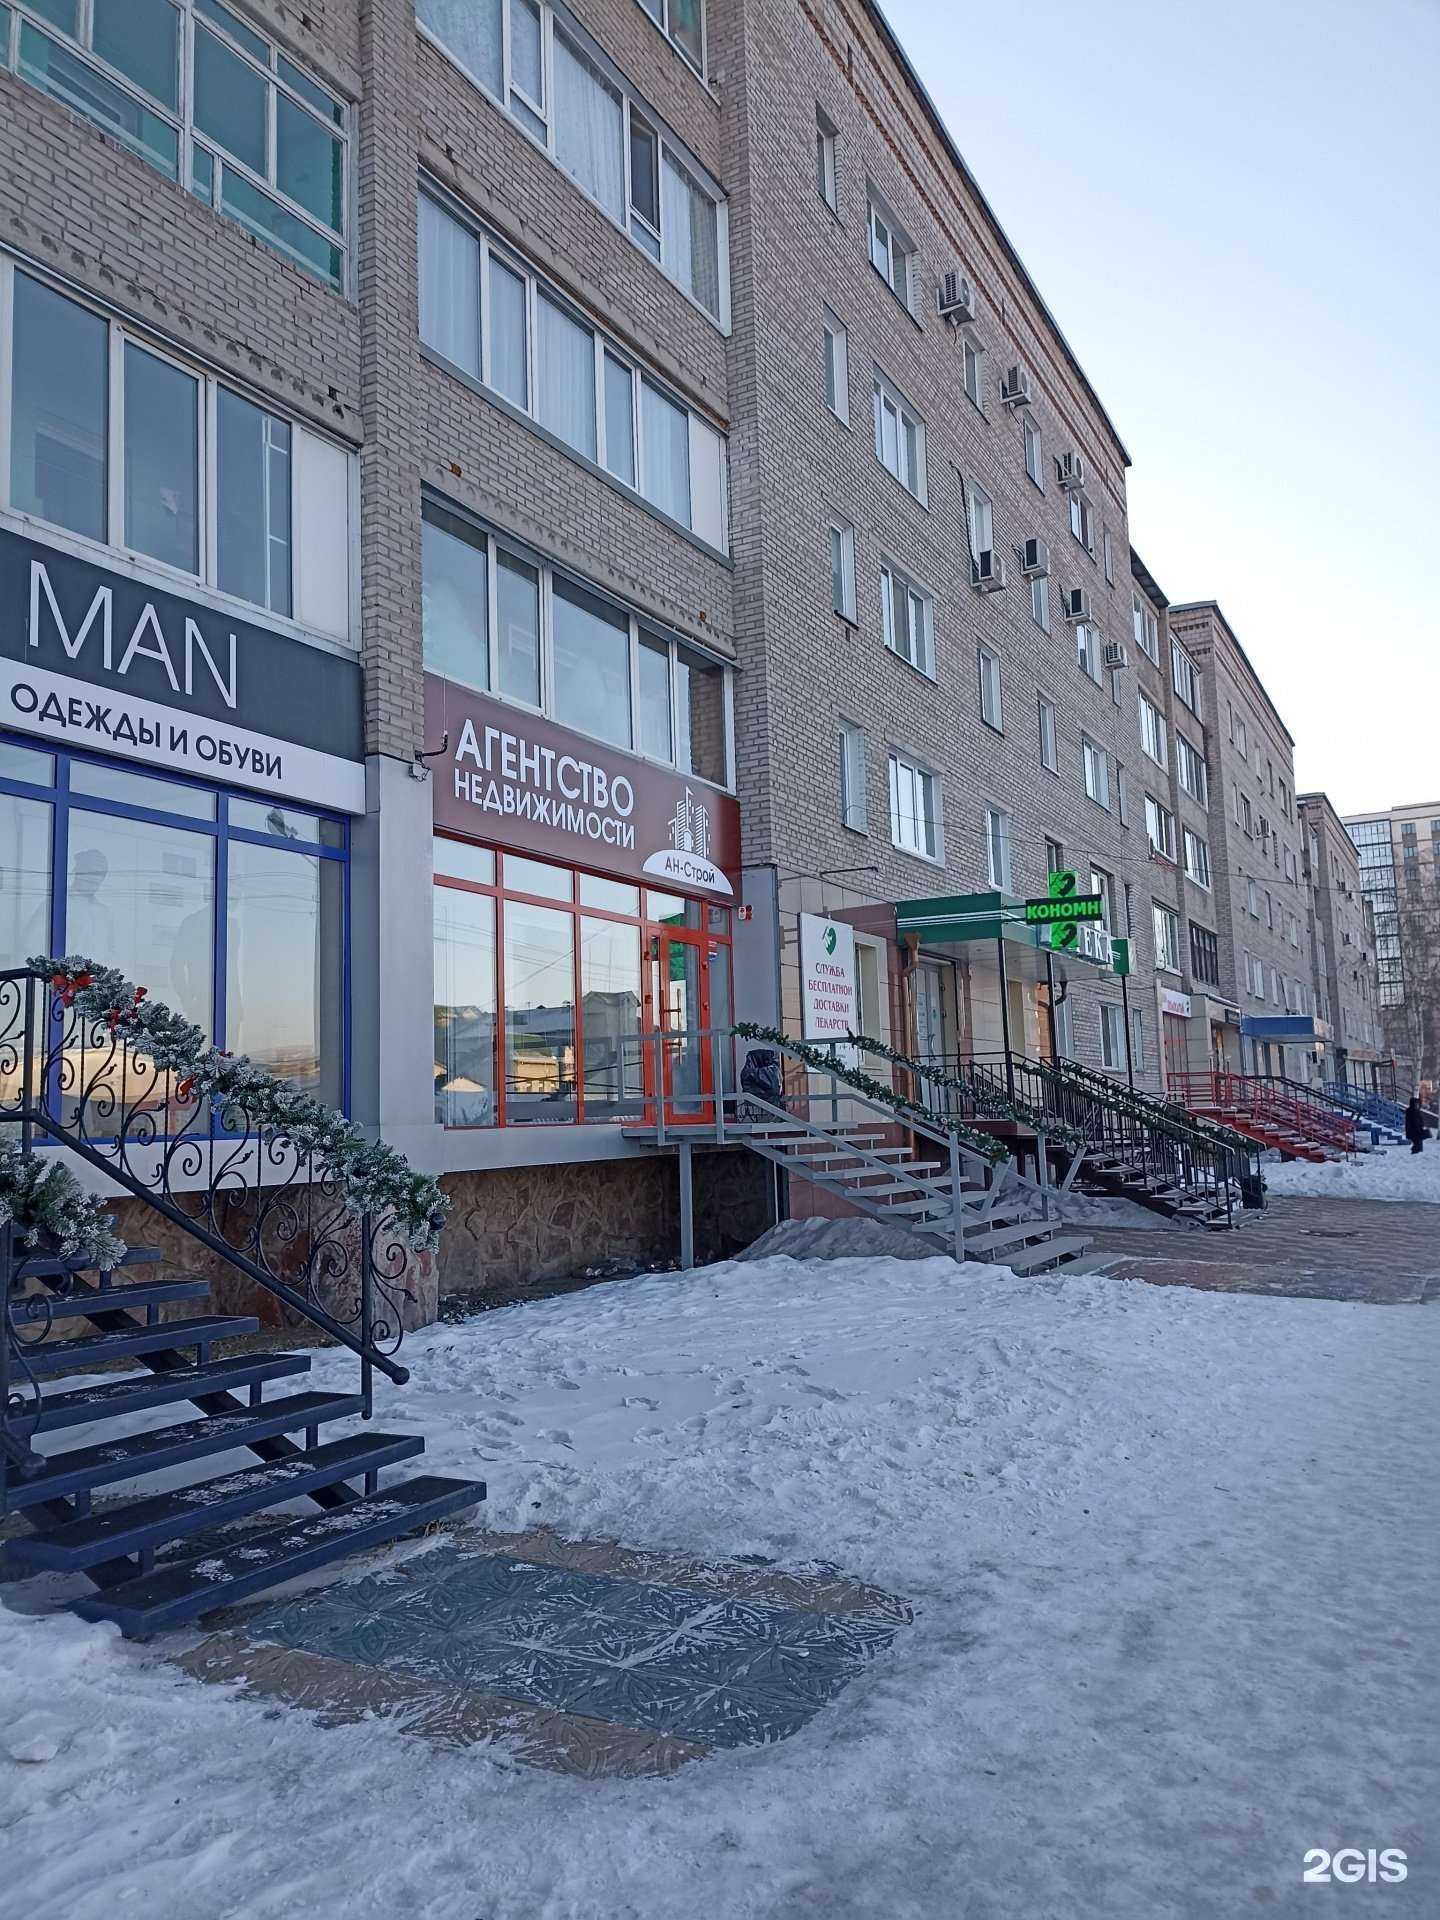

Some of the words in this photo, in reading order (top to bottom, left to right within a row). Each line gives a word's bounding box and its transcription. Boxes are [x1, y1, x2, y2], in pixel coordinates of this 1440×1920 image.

[29, 559, 237, 709] MAN
[10, 683, 161, 748] ОДЕЖДЫ
[169, 726, 188, 755] И
[195, 735, 282, 779] ОБУВИ
[455, 718, 634, 817] АГЕНТСТВО
[454, 767, 635, 850] НЕДВИЖИМОСТИ
[664, 856, 715, 883] АН-Строй
[815, 962, 845, 977] СЛУЖБА
[813, 998, 849, 1013] ДОСТАВКИ
[815, 1016, 849, 1031] ЛЕКАРСТВ
